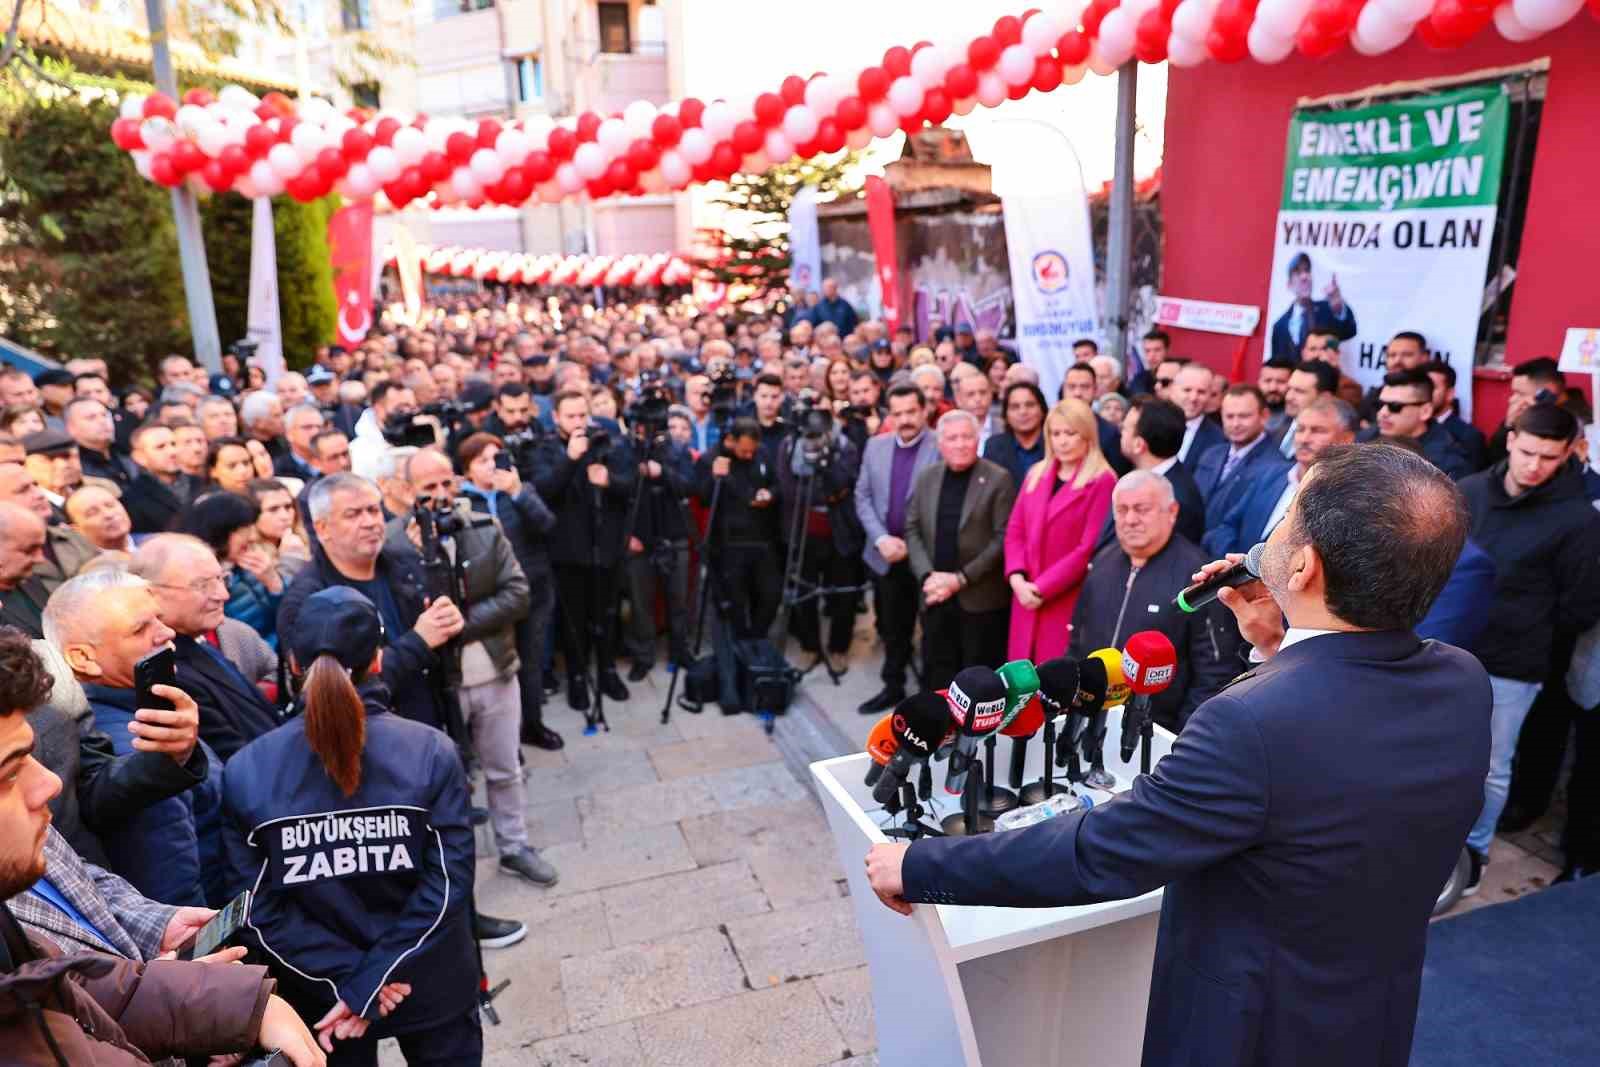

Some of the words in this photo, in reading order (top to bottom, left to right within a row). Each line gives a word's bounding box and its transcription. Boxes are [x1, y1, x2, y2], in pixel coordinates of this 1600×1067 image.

[1298, 113, 1412, 157] EMEKLİ
[1424, 101, 1485, 147] VE
[1283, 221, 1381, 248] YANINDA
[1393, 218, 1483, 249] OLAN
[281, 810, 412, 850] BÜYÜKŞEHİR
[283, 843, 414, 884] ZABITA
